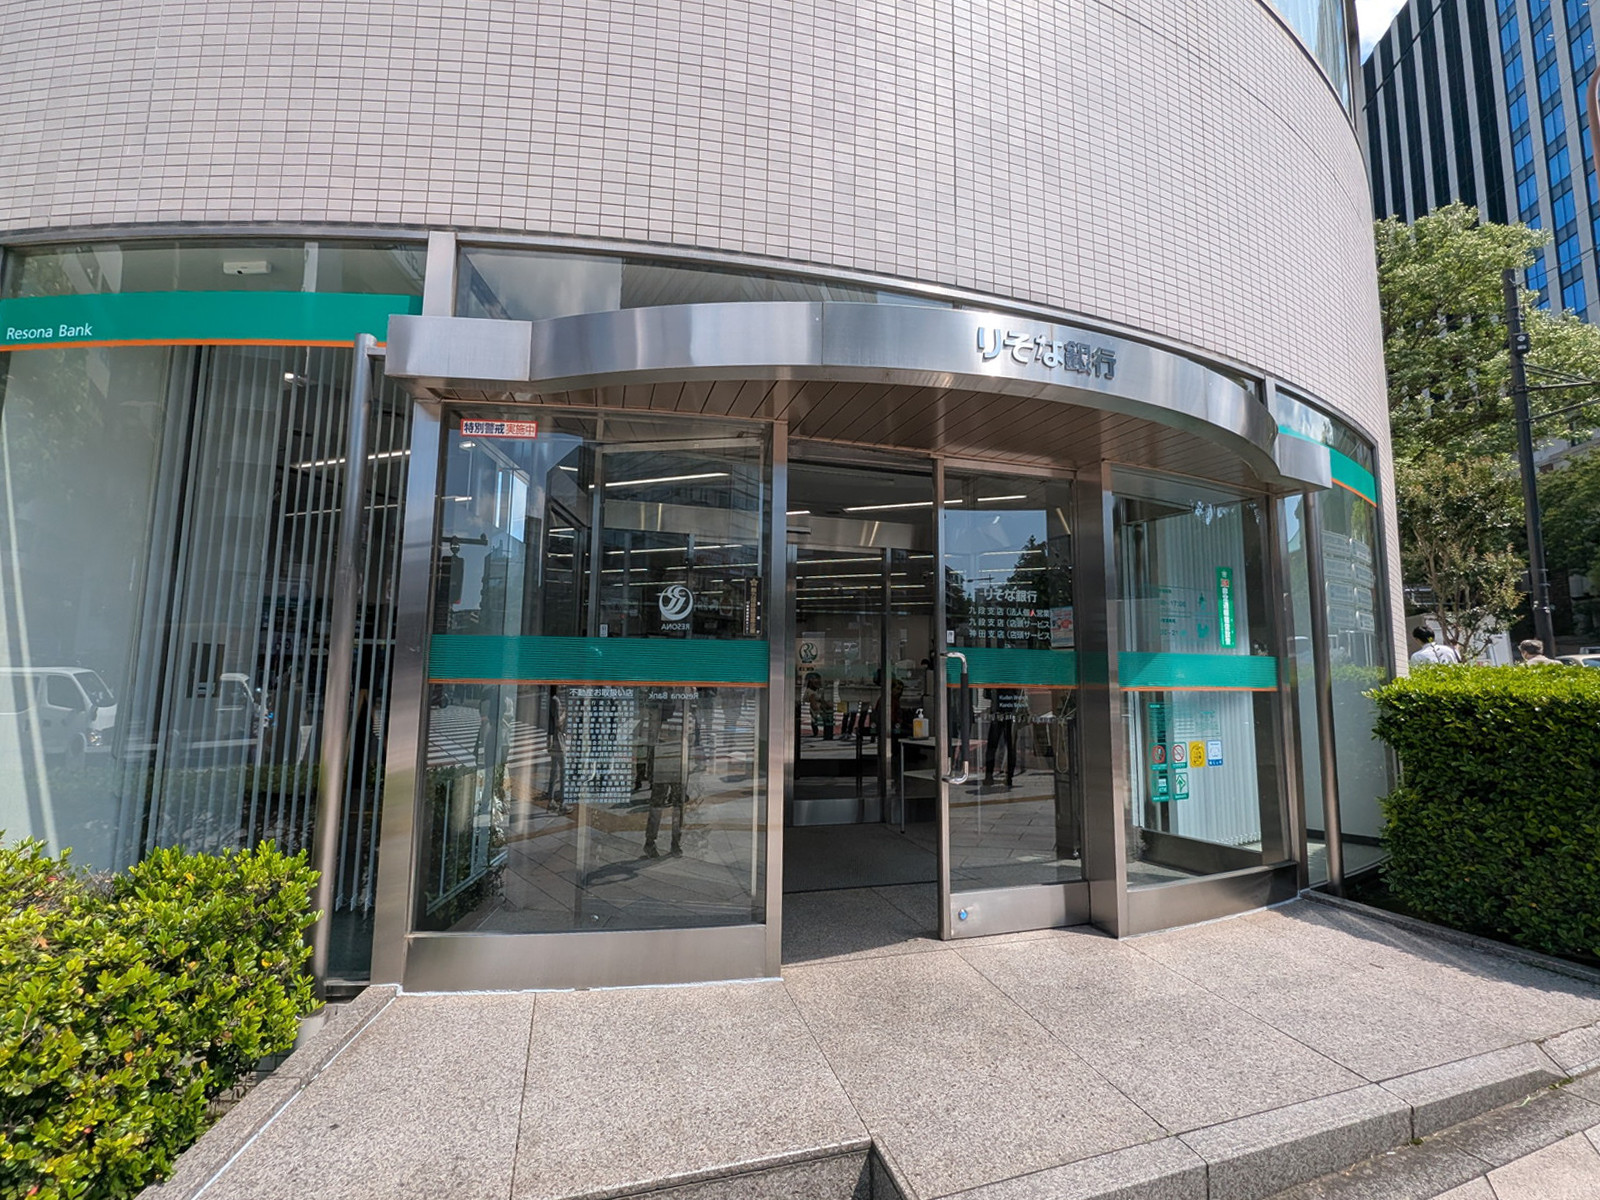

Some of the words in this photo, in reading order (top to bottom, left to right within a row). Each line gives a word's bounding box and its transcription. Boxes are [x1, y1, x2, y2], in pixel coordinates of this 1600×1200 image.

[6, 327, 53, 340] Resona
[58, 323, 94, 337] Bank
[976, 326, 1117, 380] りそな銀行
[463, 421, 535, 435] 特別警戒実施中
[983, 587, 1038, 603] りそな銀行
